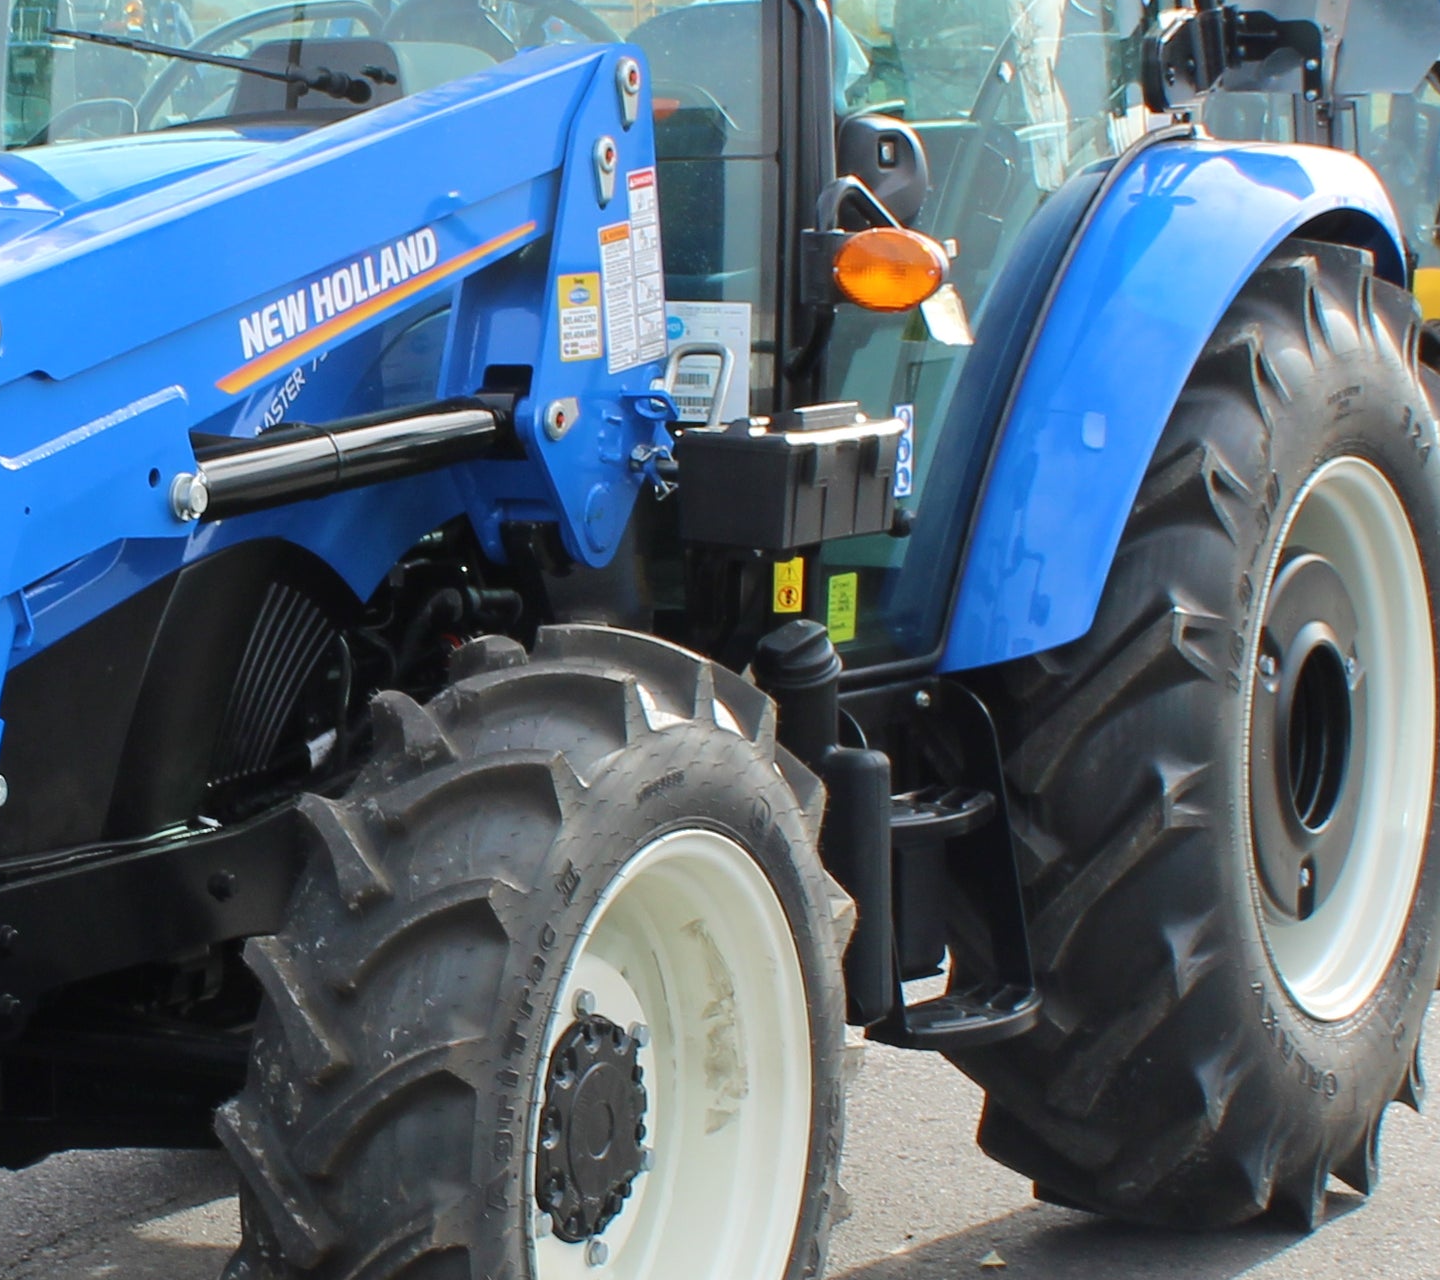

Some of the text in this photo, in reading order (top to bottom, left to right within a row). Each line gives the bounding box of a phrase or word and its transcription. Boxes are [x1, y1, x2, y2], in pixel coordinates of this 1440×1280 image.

[238, 227, 439, 359] NEW HOLLAND
[255, 367, 306, 436] ASTER
